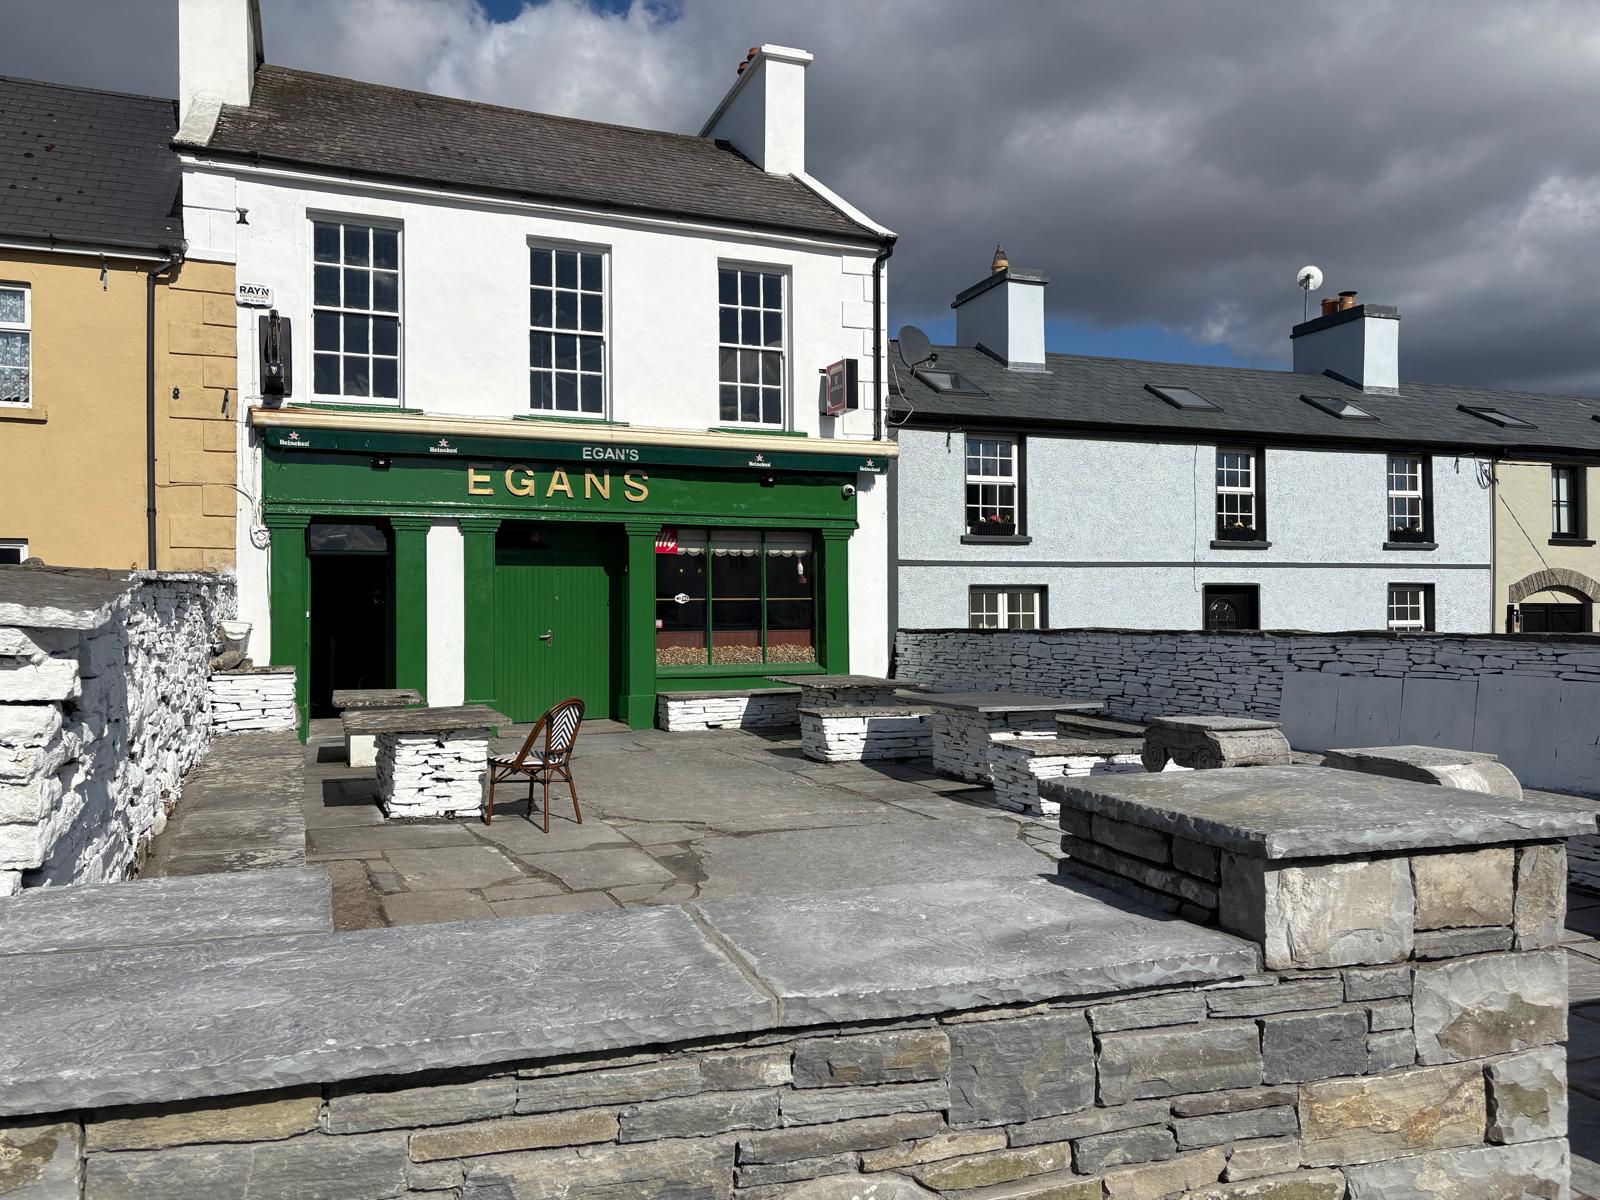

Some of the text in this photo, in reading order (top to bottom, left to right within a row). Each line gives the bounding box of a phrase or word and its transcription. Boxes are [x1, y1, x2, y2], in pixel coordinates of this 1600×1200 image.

[239, 285, 270, 296] RAYN
[582, 447, 639, 461] EGAN'S
[467, 463, 649, 502] EGANS
